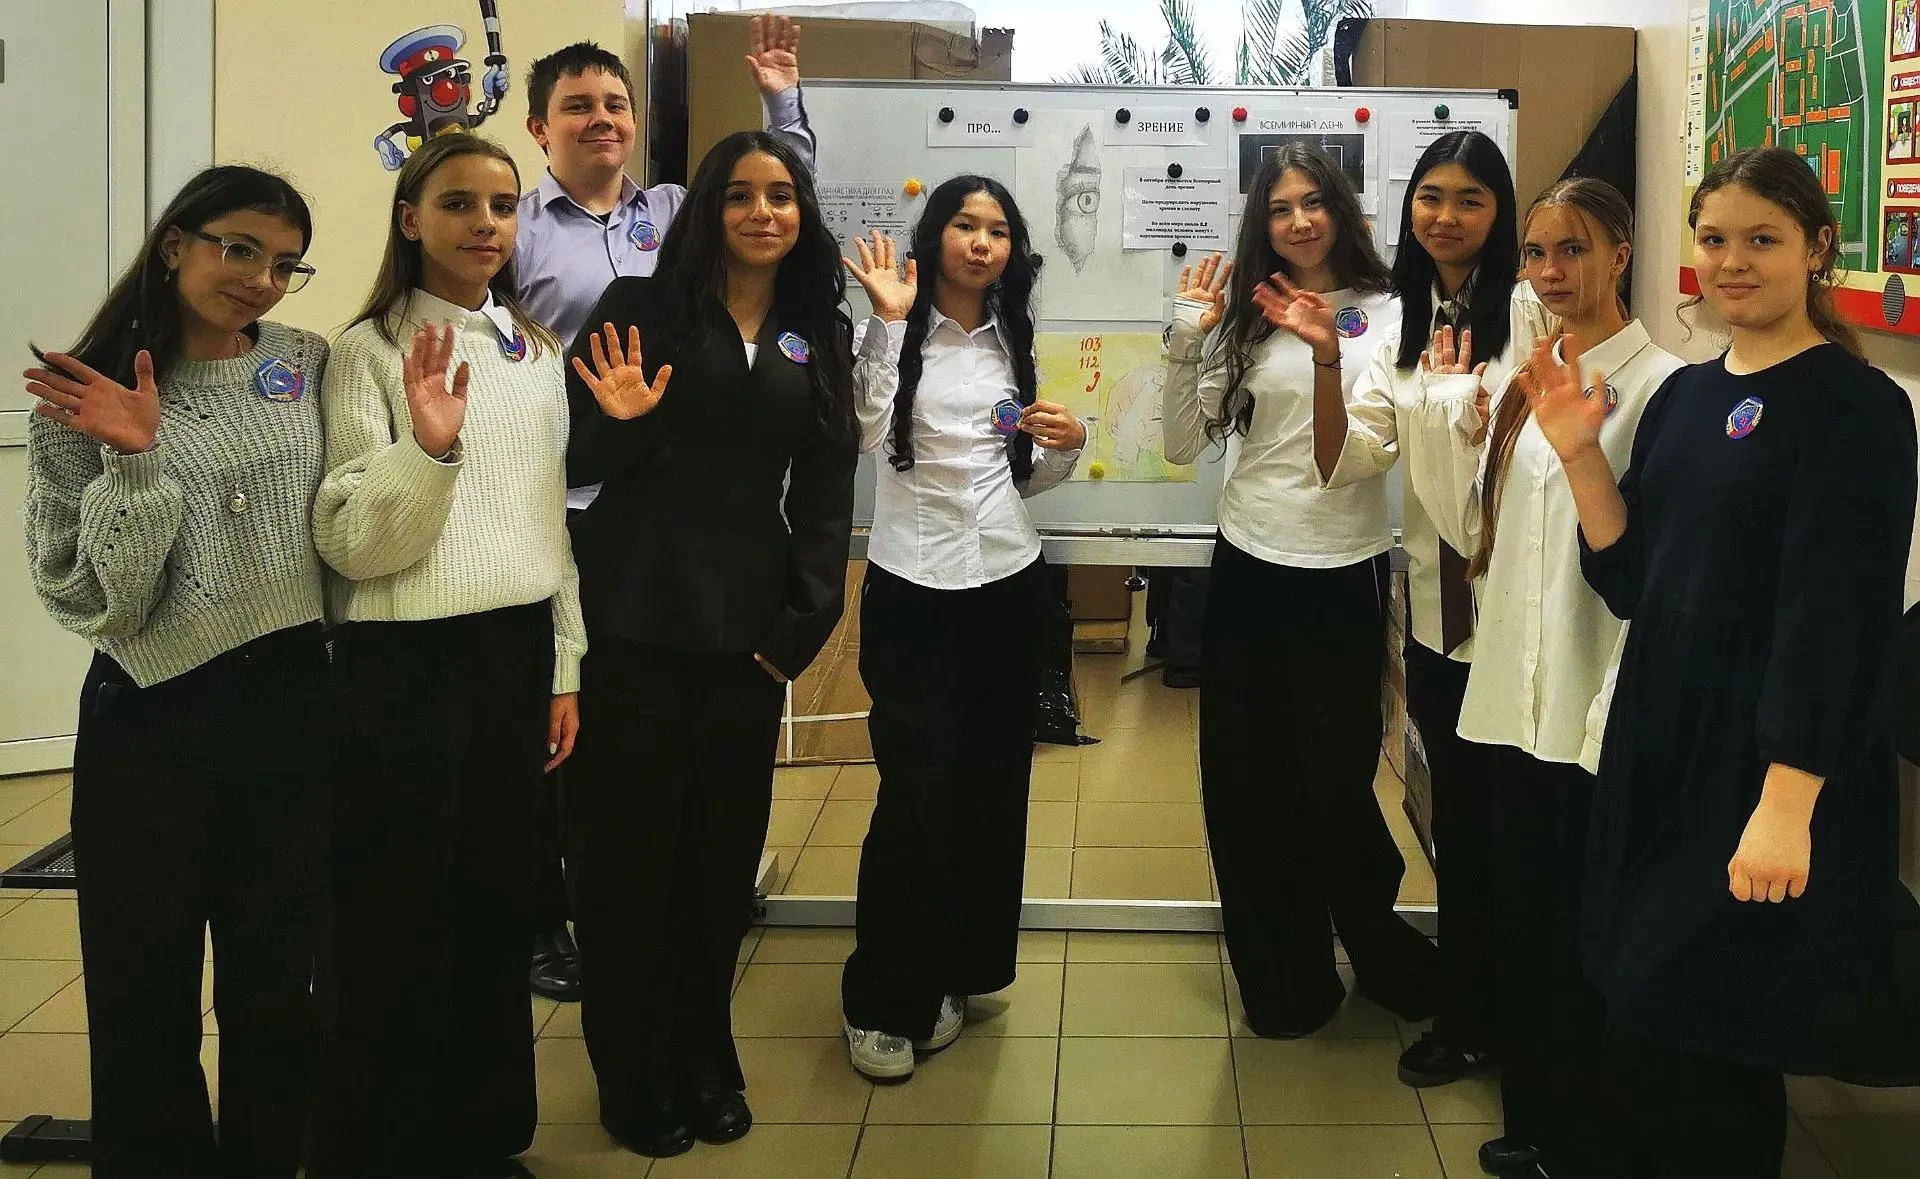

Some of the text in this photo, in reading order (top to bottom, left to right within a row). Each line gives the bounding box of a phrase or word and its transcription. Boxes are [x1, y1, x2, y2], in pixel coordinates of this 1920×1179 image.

[967, 123, 1001, 133] ПРО...
[1137, 122, 1184, 133] ЗРЕНИЕ
[1259, 119, 1344, 130] ВСЕМИРНЫЙ ДЕНЬ
[1080, 337, 1101, 351] 103
[1079, 356, 1100, 369] 112
